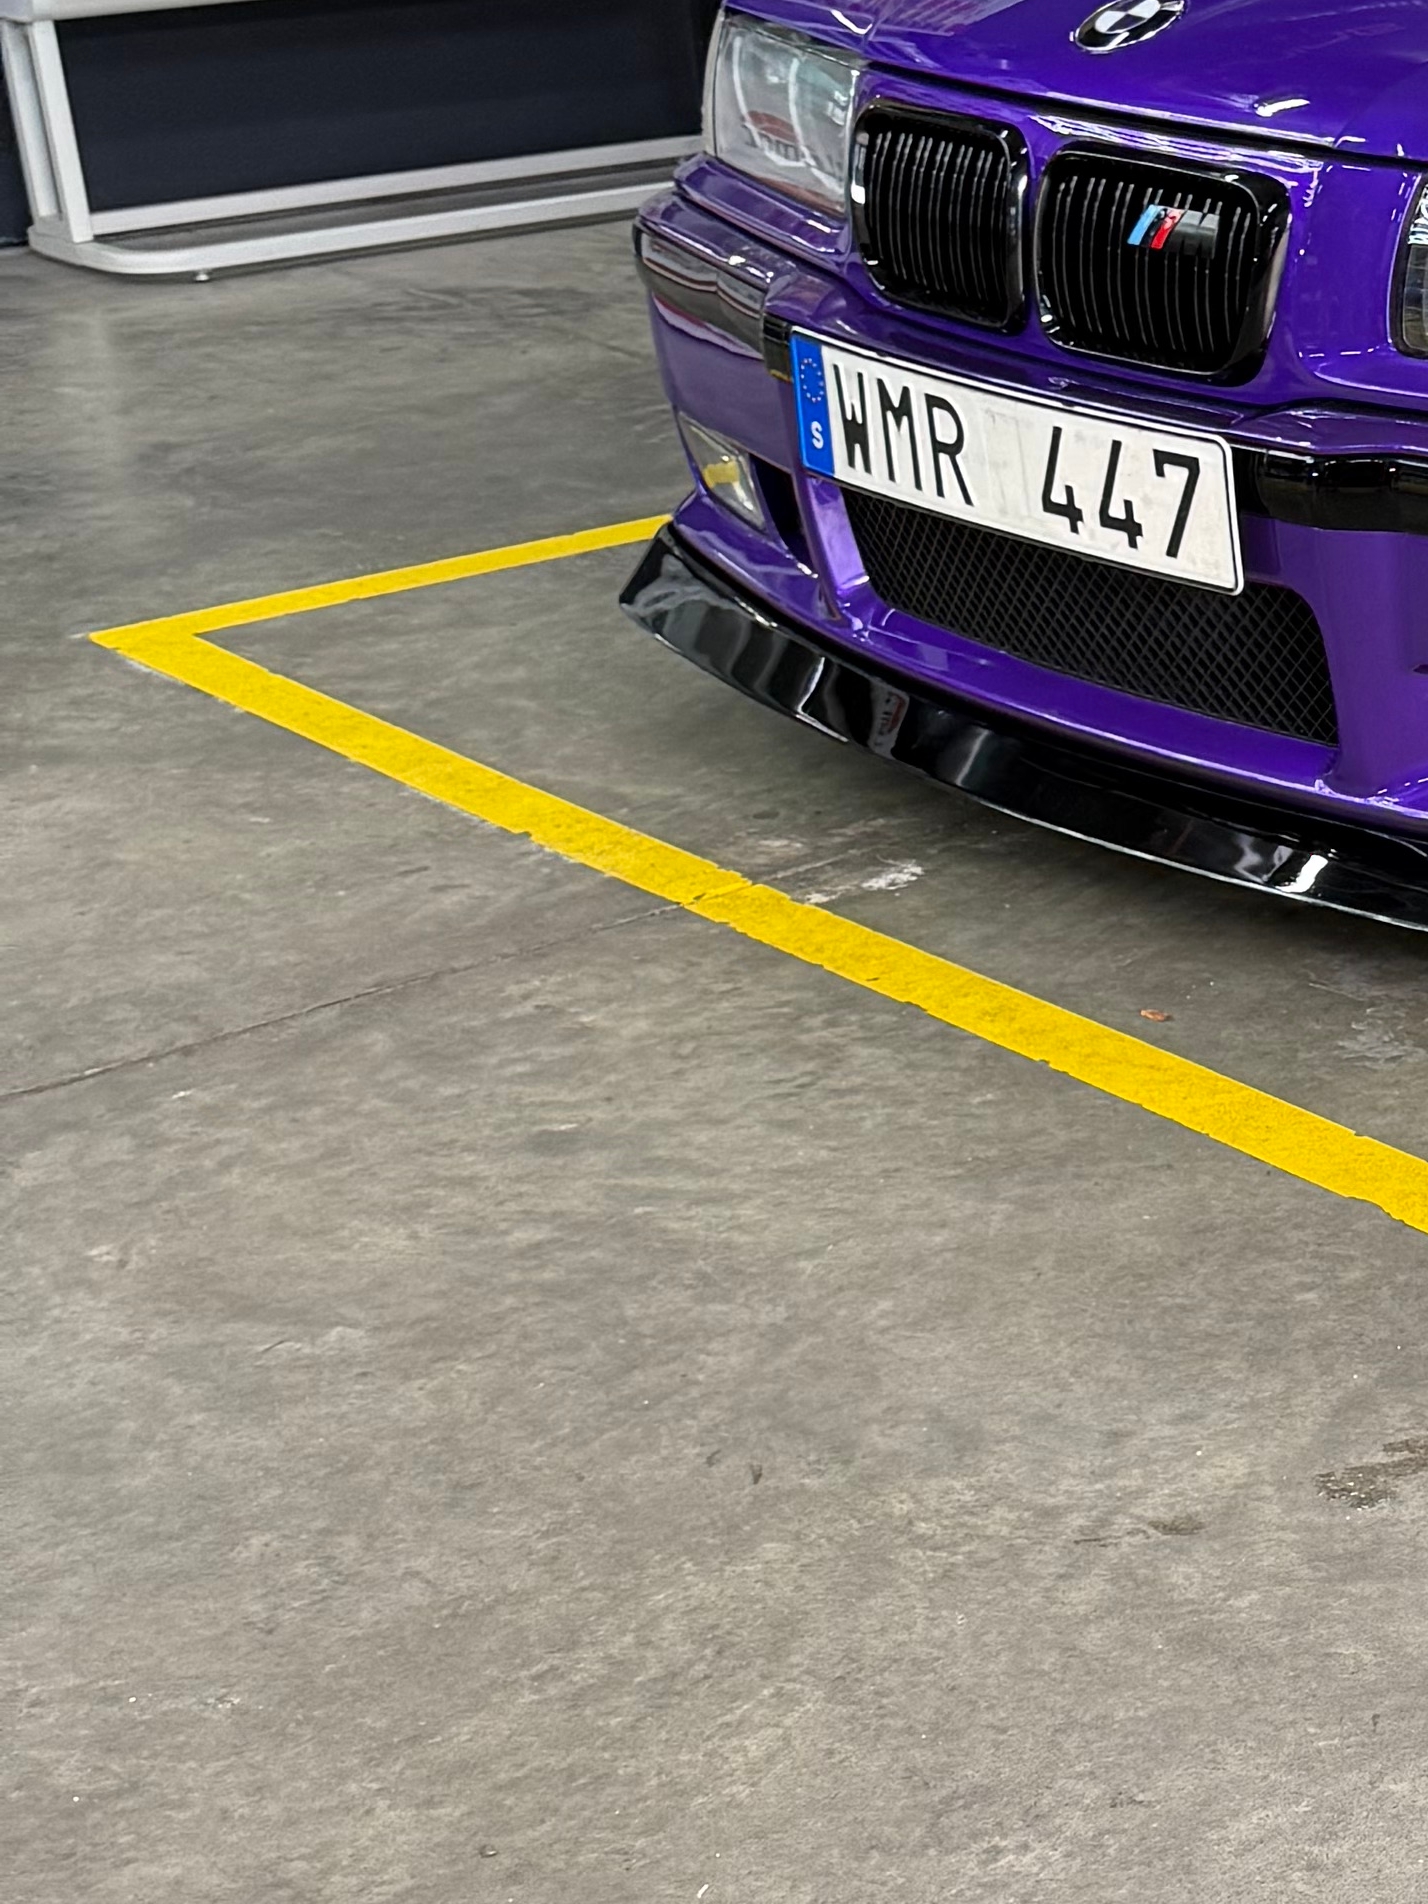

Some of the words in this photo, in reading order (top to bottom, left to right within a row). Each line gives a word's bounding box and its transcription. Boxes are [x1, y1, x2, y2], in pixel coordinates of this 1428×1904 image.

[811, 420, 824, 450] S
[833, 363, 974, 507] WMR
[1041, 426, 1200, 560] 447
